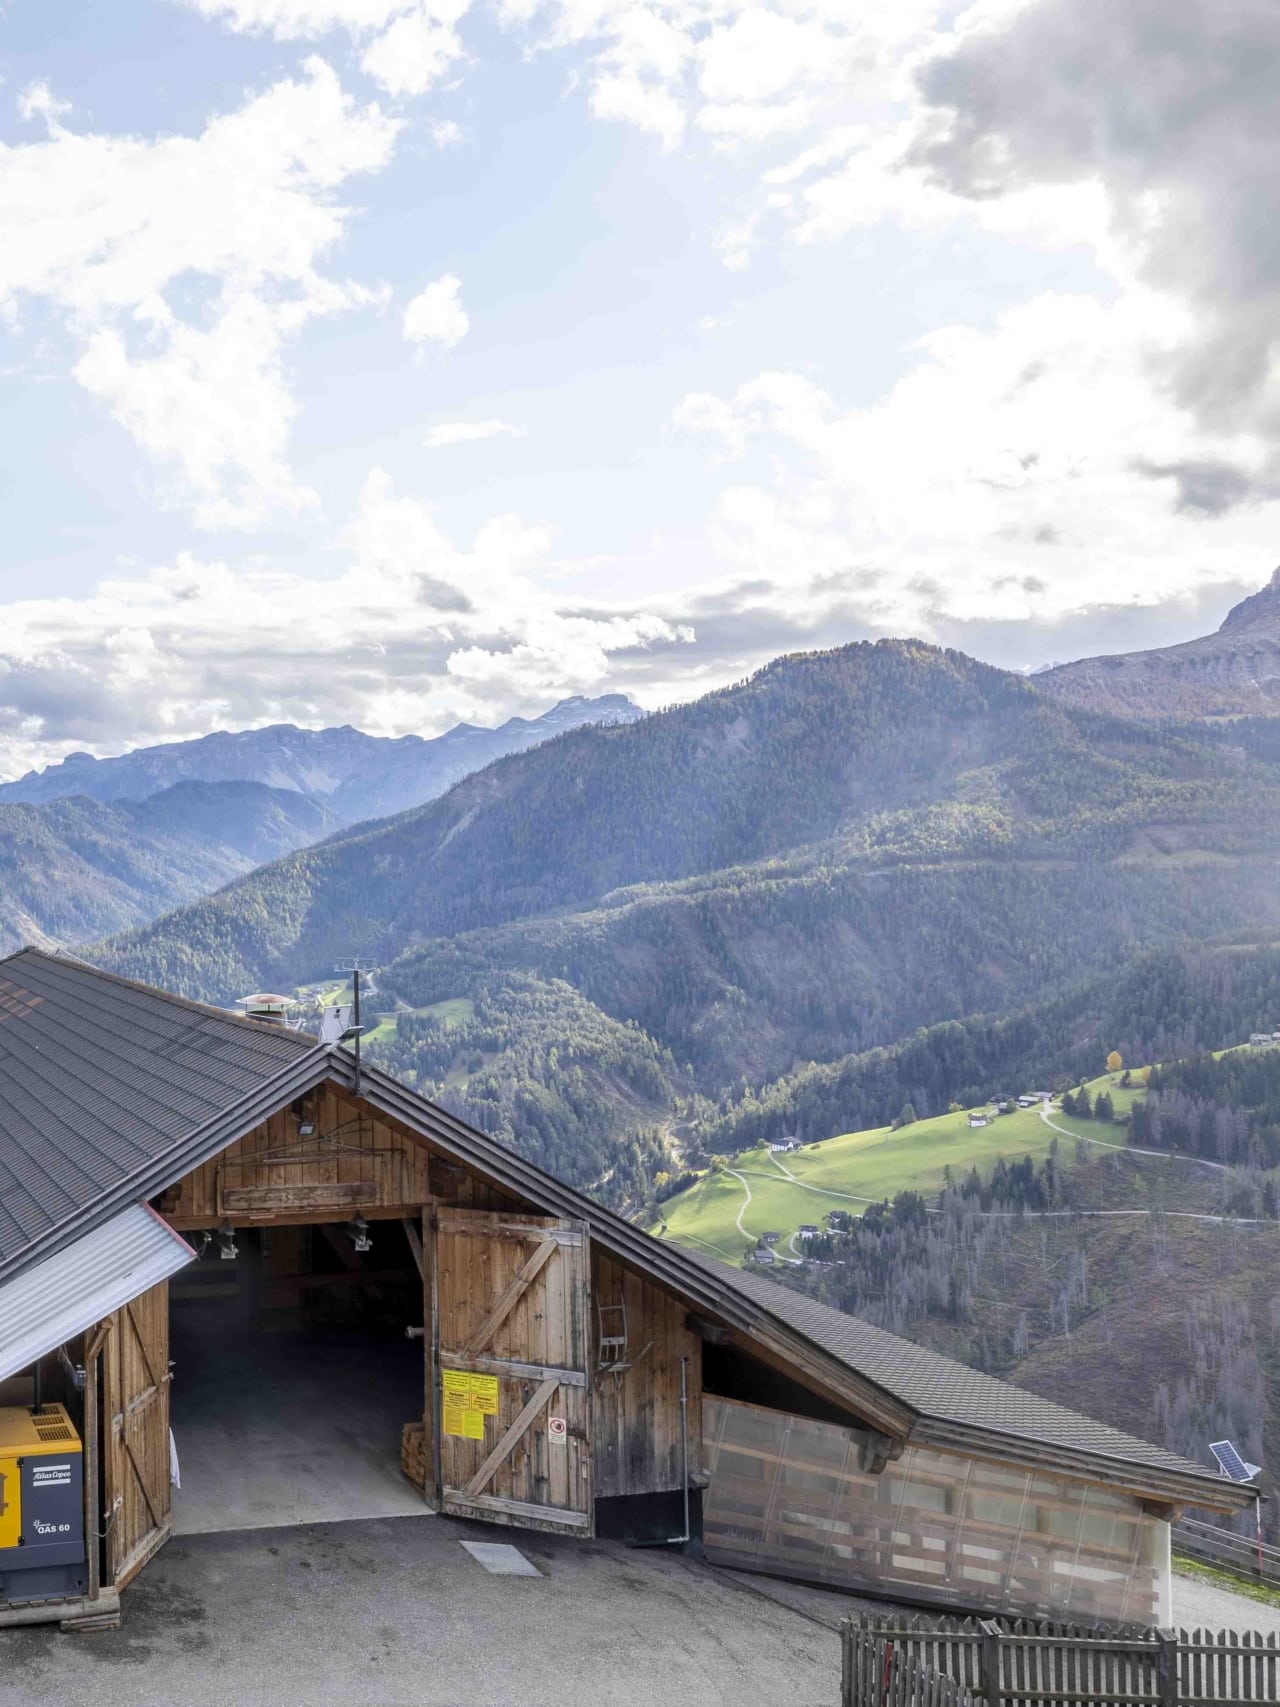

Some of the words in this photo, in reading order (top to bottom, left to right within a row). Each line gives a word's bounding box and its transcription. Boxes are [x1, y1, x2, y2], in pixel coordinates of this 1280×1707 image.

[33, 1472, 52, 1481] Atlas
[52, 1471, 71, 1480] Copco
[37, 1525, 57, 1534] QAS
[58, 1523, 71, 1532] 60
